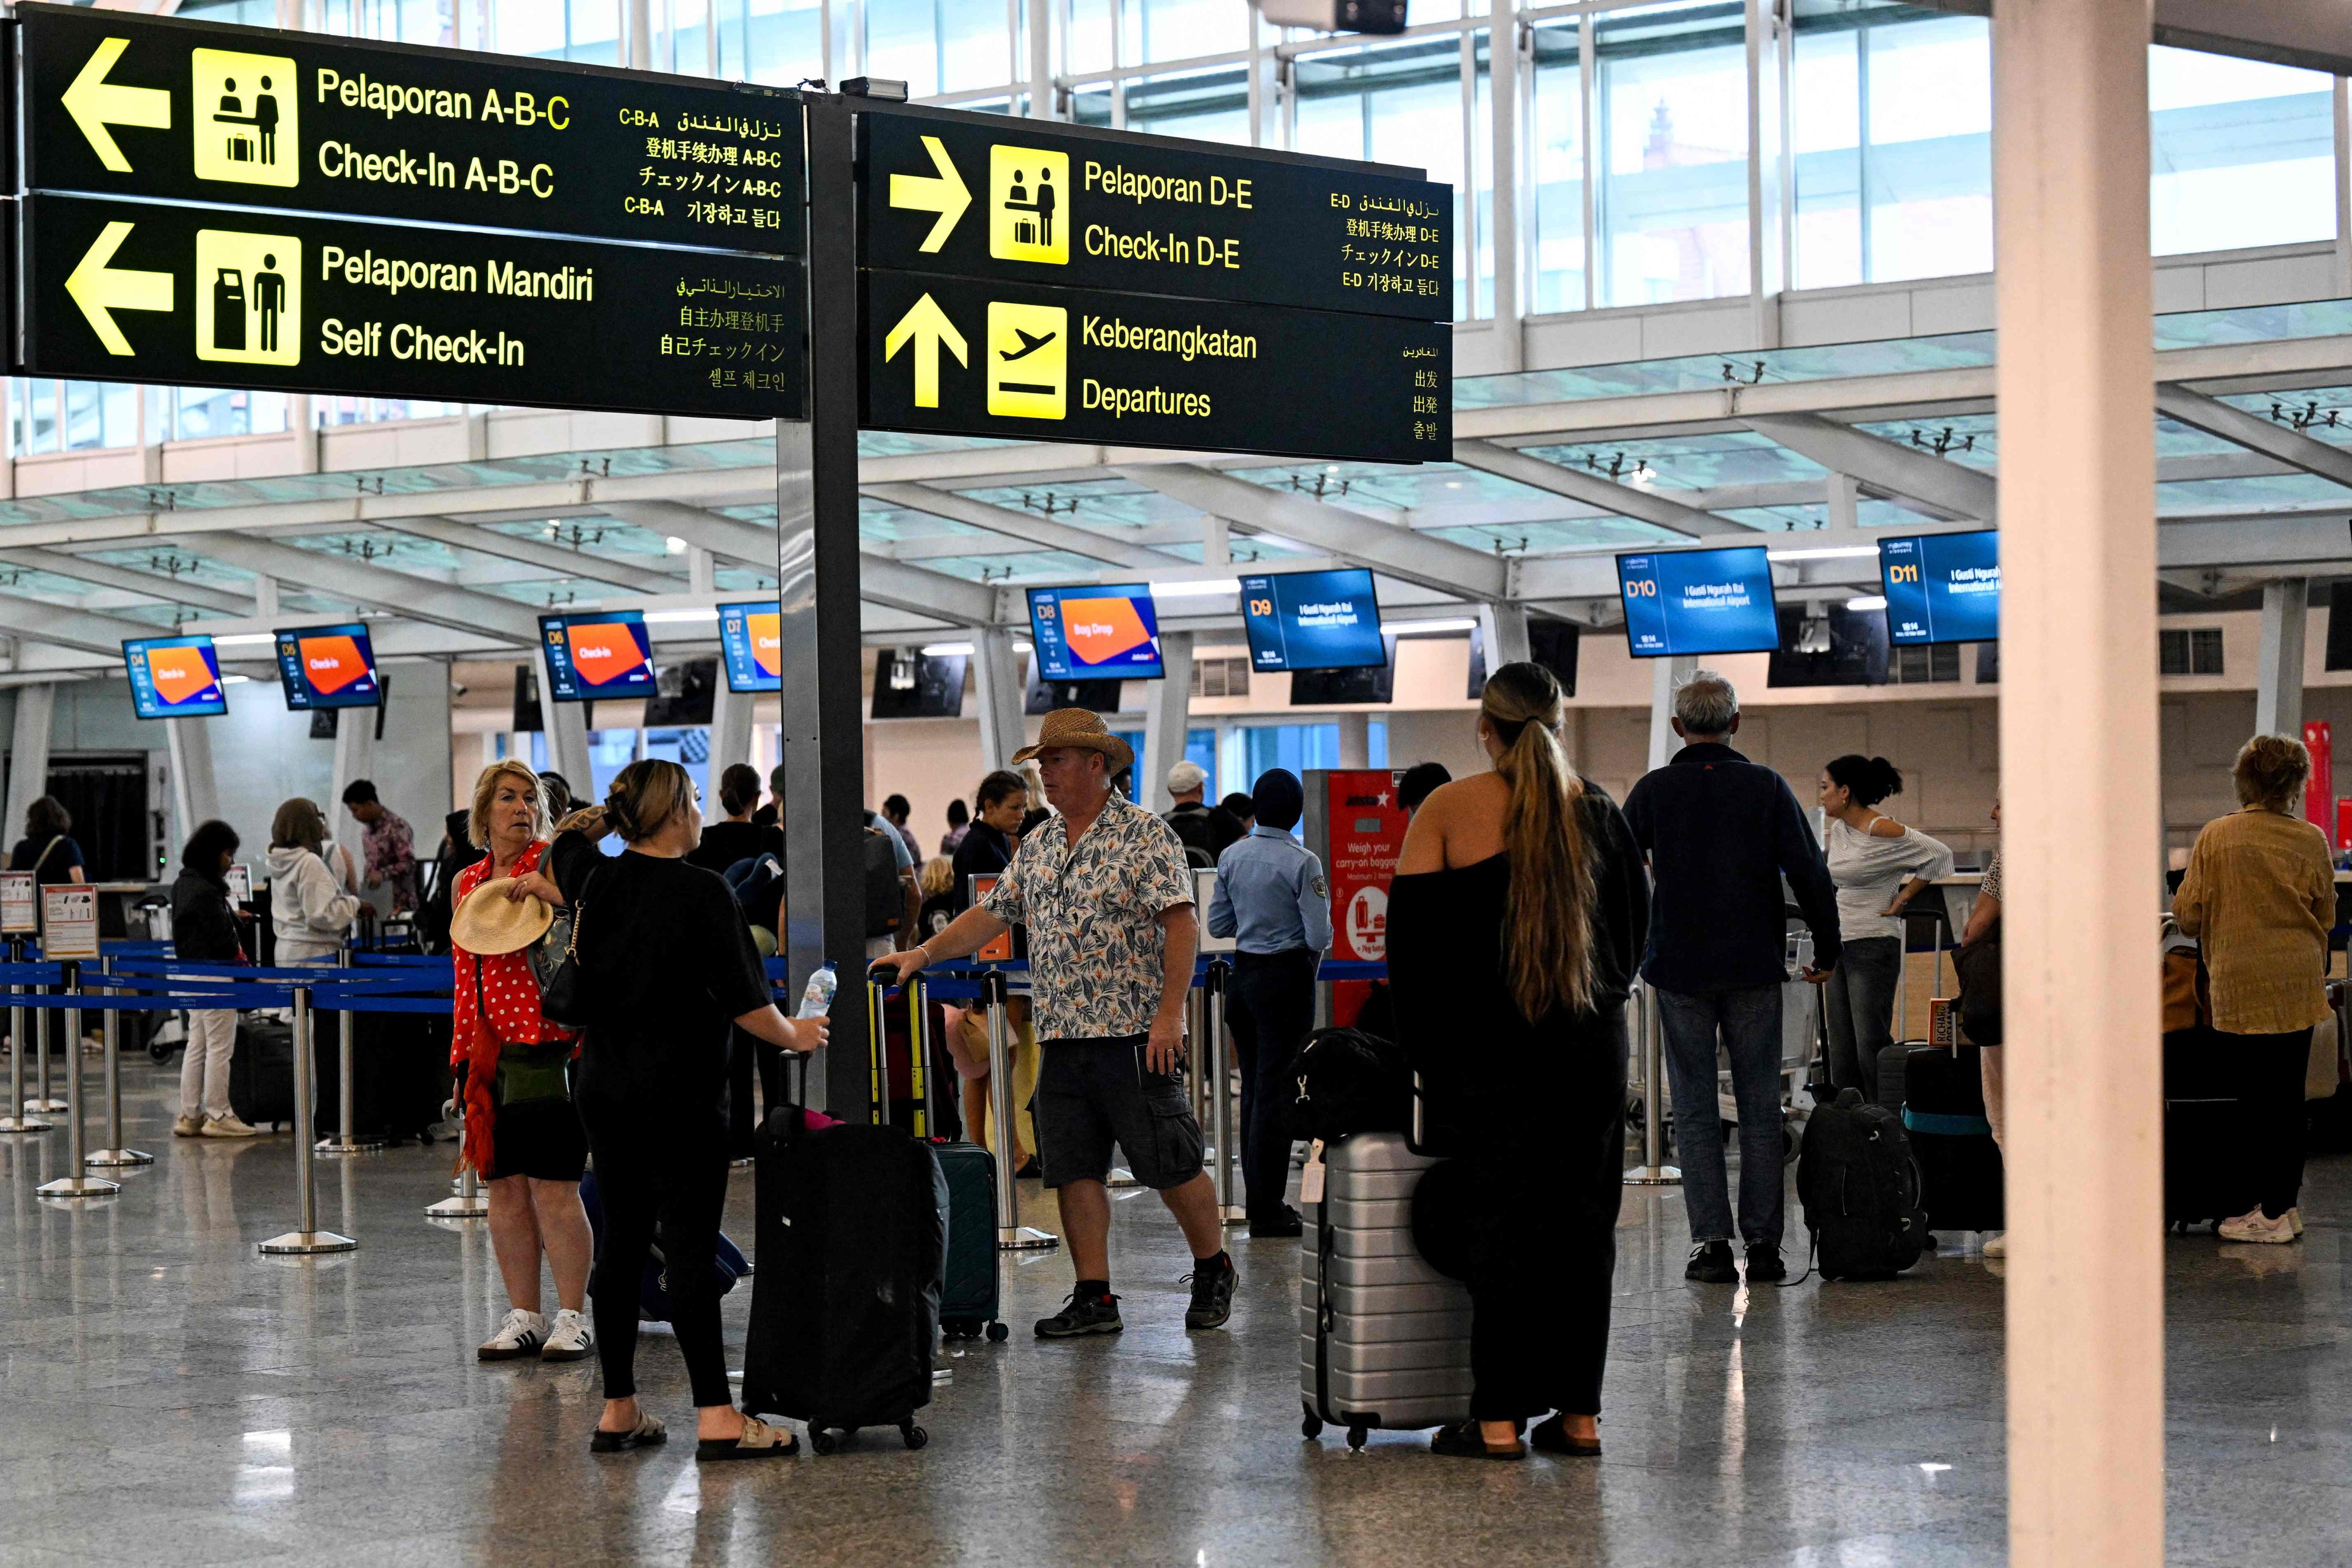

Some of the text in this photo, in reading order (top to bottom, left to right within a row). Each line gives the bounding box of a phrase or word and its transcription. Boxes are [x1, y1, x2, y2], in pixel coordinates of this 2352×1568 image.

[318, 68, 570, 130] Pelaporan A-B-C
[620, 109, 659, 128] C-B-A
[646, 137, 781, 168] 登机手续办理 A-B-C
[319, 141, 554, 198] Check-In A-B-C
[639, 166, 781, 198] チェックイン A-B-C
[1086, 161, 1252, 208] Pelaporan D-E
[1331, 193, 1350, 208] E-D
[625, 196, 781, 229] C-B-A 기장하고 들다
[1347, 219, 1439, 242] 登机手续办理 D-E
[1085, 225, 1239, 269] Check-In D-E
[1341, 244, 1439, 268] チェックイン D-E
[323, 246, 592, 301] Pelaporan Mandiri
[1343, 272, 1439, 296] E-D 기장하고 들다
[681, 306, 784, 333] 自主办理登机手
[321, 318, 524, 366] Self Check-In
[662, 334, 784, 362] 自己チェックイン
[1083, 315, 1256, 361] Keberangkatan
[709, 368, 783, 391] 셀프 체크인
[1415, 369, 1436, 387] 出发
[1083, 379, 1210, 418] Departures
[1414, 395, 1437, 413] 出発
[1413, 421, 1438, 439] 출발
[1890, 565, 1918, 583] D11
[1955, 568, 1974, 580] Gusti
[1626, 580, 1656, 598] D10
[1689, 584, 1706, 596] Gusti
[1706, 582, 1732, 598] Ngurah
[1733, 582, 1744, 594] Rai
[1948, 580, 1994, 594] International
[1037, 605, 1056, 619] D8
[1250, 598, 1272, 616] D9
[1682, 595, 1750, 609] International Airport
[1073, 622, 1113, 638] Bag Drop
[1348, 842, 1390, 855] Weigh your
[1336, 859, 1368, 870] carry-on
